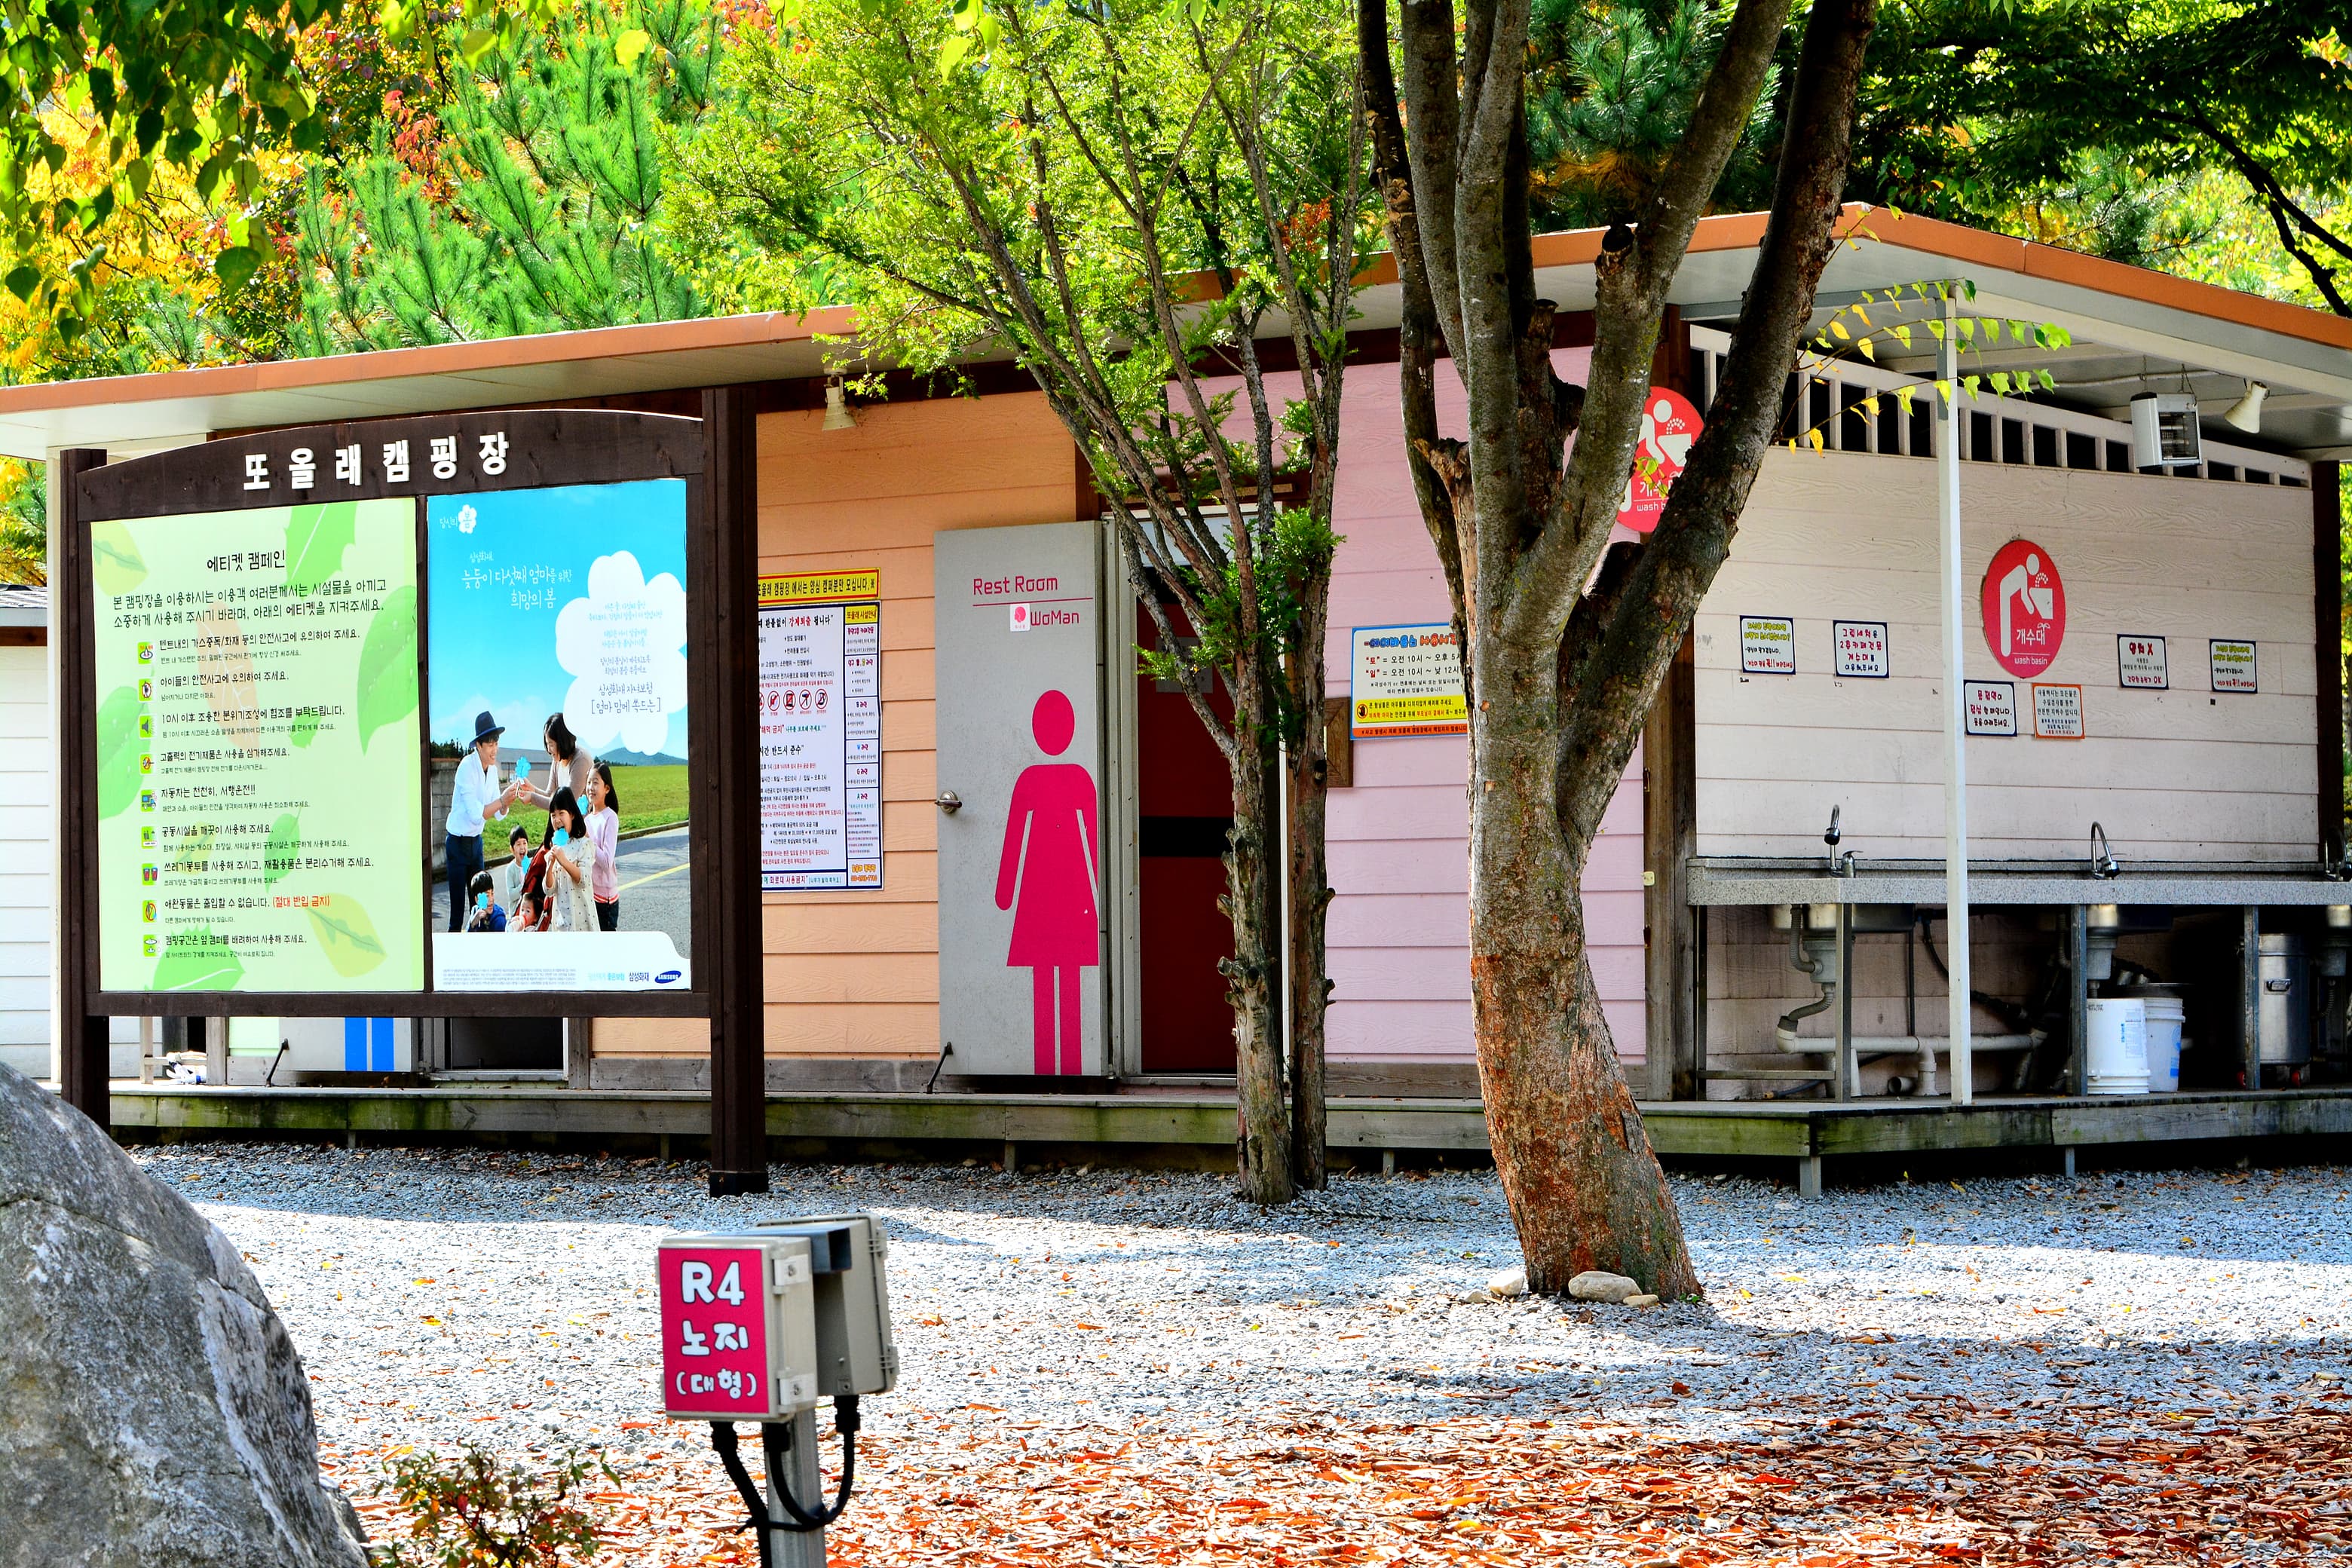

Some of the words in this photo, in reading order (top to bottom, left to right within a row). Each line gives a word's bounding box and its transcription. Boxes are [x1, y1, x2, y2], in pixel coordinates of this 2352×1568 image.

[243, 432, 510, 490] 또올래캠핑장
[1637, 501, 1658, 512] wash
[463, 513, 472, 528] 봄
[207, 553, 243, 572] 에티켓
[248, 550, 285, 571] 캠페인
[462, 570, 492, 590] 늦둥이
[495, 566, 527, 586] 다섯째
[529, 564, 556, 584] 엄마를
[559, 571, 572, 583] 위한
[774, 582, 790, 596] 캠핑장
[792, 581, 807, 595] 에서는
[810, 580, 820, 594] 양심
[822, 578, 844, 593] 캠퍼분만
[846, 577, 869, 592] 모십니다.
[973, 577, 1010, 596] Rest
[1015, 575, 1058, 593] Room
[113, 596, 122, 611] 본
[125, 593, 163, 609] 캠핑장을
[167, 590, 214, 606] 이용하시는
[217, 587, 246, 602] 이용객
[250, 583, 308, 599] 여러분께서는
[311, 580, 352, 596] 시설물을
[356, 579, 386, 593] 아끼고
[511, 591, 542, 610] 희망의
[544, 588, 556, 609] 봄
[114, 614, 151, 629] 소중하게
[155, 611, 182, 626] 사용해
[186, 609, 214, 623] 주시기
[218, 607, 250, 620] 바라며,
[253, 605, 282, 618] 아래의
[286, 601, 325, 617] 에티켓을
[329, 599, 384, 613] 지켜주세요.
[1031, 610, 1080, 626] WoMan
[159, 639, 188, 651] 텐트내의
[191, 635, 239, 648] 가스중독/화재
[242, 634, 256, 646] 등의
[259, 632, 297, 645] 안전사고에
[300, 630, 331, 642] 유의하여
[334, 629, 360, 639] 주세요.
[2016, 627, 2045, 646] 개수대
[2147, 642, 2154, 656] X
[1366, 656, 1380, 665] "토"
[1391, 655, 1404, 664] 오전
[1407, 654, 1423, 663] 10시
[1435, 653, 1448, 661] 오후
[2014, 657, 2029, 665] wash
[2031, 656, 2048, 666] basin
[160, 675, 189, 687] 아이들의
[191, 673, 229, 686] 안전사고에
[231, 672, 261, 683] 유의하여
[264, 671, 289, 681] 주세요.
[1365, 669, 1380, 678] "일"
[1391, 668, 1404, 677] 오전
[1407, 667, 1423, 675] 10시
[1435, 666, 1441, 675] 낮
[1444, 666, 1459, 674] 12시
[2153, 675, 2162, 684] OK
[599, 684, 625, 696] 삼성화재
[626, 682, 653, 694] 자녀보험
[162, 714, 179, 724] 10시
[181, 712, 195, 722] 이후
[198, 711, 220, 723] 조용한
[222, 709, 268, 721] 분위기조성에
[270, 707, 292, 719] 협조를
[296, 705, 345, 718] 부탁드립니다.
[160, 751, 187, 762] 고출력의
[188, 749, 222, 761] 전기제품은
[224, 748, 244, 759] 사용을
[247, 747, 290, 758] 삼가해주세요.
[161, 787, 190, 799] 자동차는
[193, 786, 218, 798] 천천히,
[220, 784, 256, 797] 서행운전!!
[161, 825, 198, 838] 공동시설을
[200, 825, 222, 836] 깨끗이
[225, 823, 247, 835] 사용해
[249, 823, 274, 834] 주세요.
[164, 860, 208, 873] 쓰레기봉투를
[211, 860, 234, 871] 사용해
[236, 860, 262, 870] 주시고,
[264, 858, 302, 870] 재활용품은
[305, 858, 345, 869] 분리수거해
[348, 857, 374, 868] 주세요.
[164, 898, 201, 910] 애완동물은
[204, 898, 225, 909] 출입할
[228, 899, 235, 908] 수
[237, 897, 270, 908] 없습니다.
[273, 896, 290, 908] (절대
[293, 896, 308, 908] 반입
[311, 896, 329, 907] 금지)
[165, 935, 199, 946] 캠핑공간은
[201, 935, 207, 945] 옆
[209, 935, 229, 945] 캠퍼를
[231, 935, 259, 945] 배려하여
[261, 934, 281, 945] 사용해
[283, 934, 307, 943] 주세요.
[629, 972, 650, 982] 삼성화재
[681, 1260, 746, 1306] R4
[681, 1320, 749, 1356] 노지
[676, 1368, 757, 1400] (대형)
